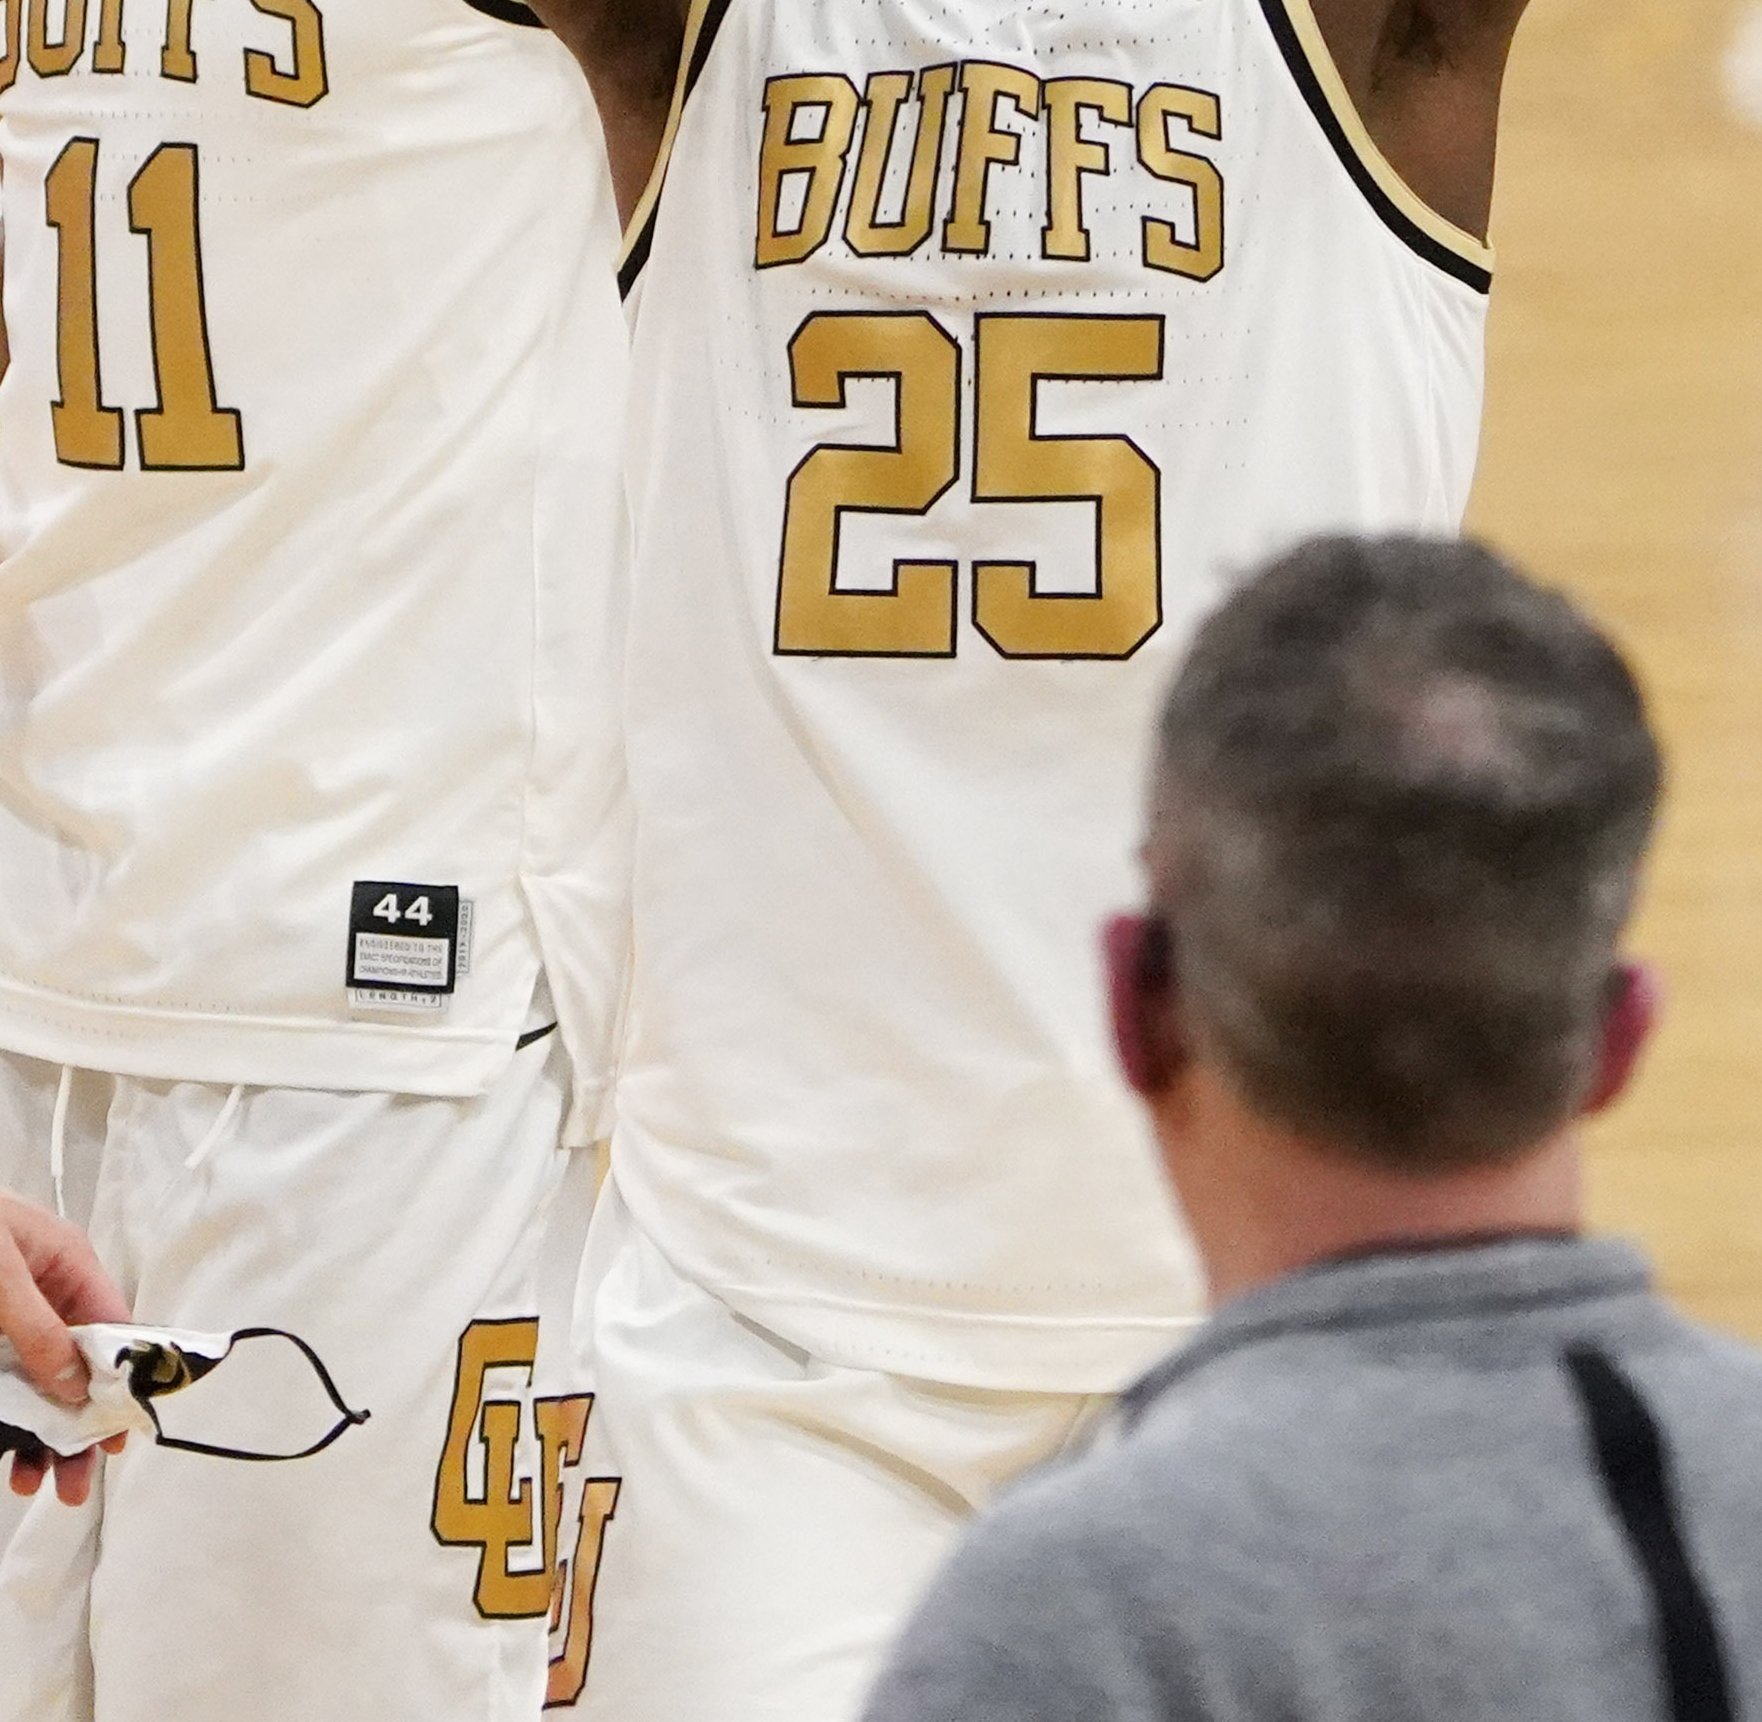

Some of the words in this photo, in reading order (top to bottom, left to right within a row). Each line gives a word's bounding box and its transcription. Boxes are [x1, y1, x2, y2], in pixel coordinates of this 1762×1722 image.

[44, 135, 245, 472] 11
[754, 59, 1225, 283] BUFFS
[773, 311, 1166, 661] 25
[372, 892, 433, 926] 44
